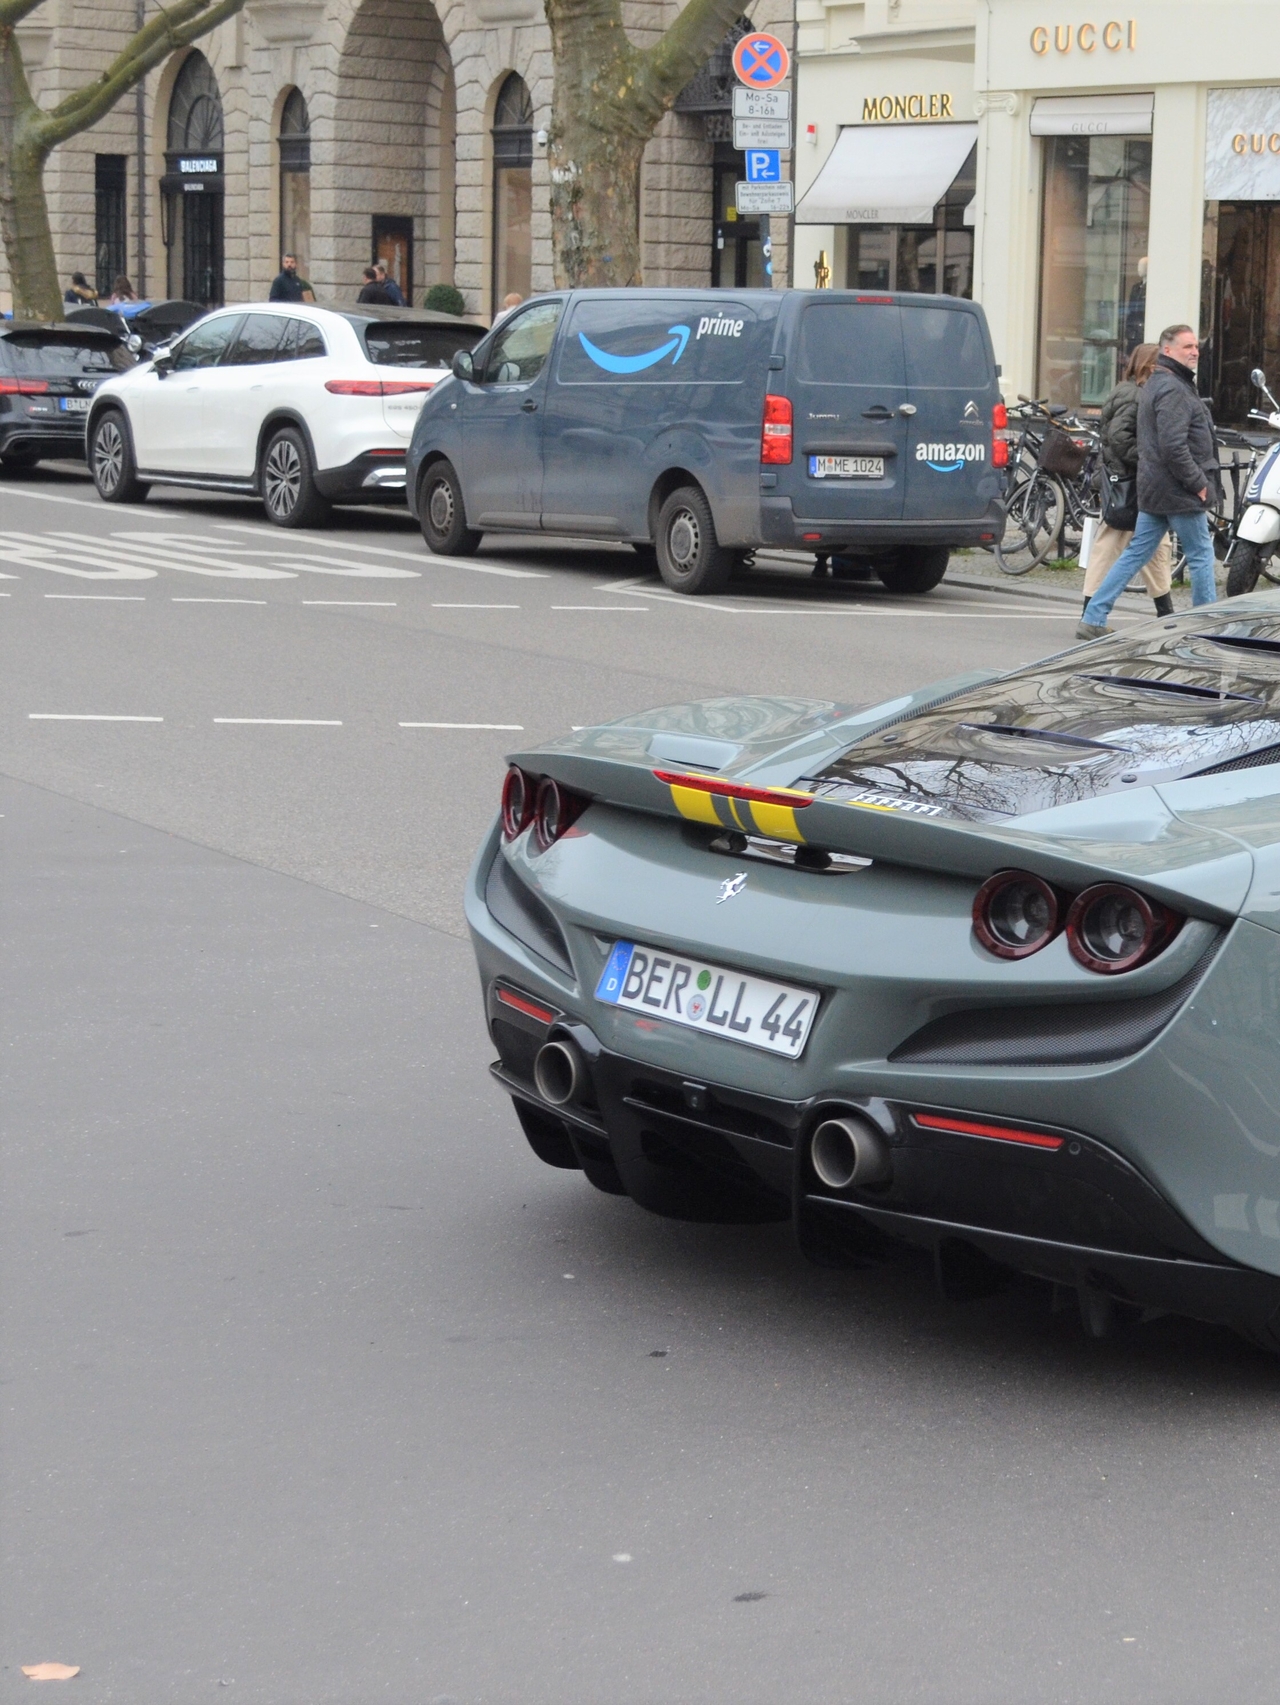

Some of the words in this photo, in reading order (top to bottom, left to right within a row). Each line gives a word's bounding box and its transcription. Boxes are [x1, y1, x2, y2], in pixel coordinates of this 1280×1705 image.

[1030, 19, 1136, 55] GUCCI
[745, 92, 778, 103] Mo-Sa
[862, 93, 953, 121] MONCLER
[748, 105, 775, 115] 8-16h
[1071, 122, 1108, 133] GUCCI
[180, 159, 217, 173] BALENCIAGA
[751, 152, 770, 179] P
[845, 209, 879, 220] MONCLER
[696, 312, 744, 340] prime
[915, 442, 985, 461] amazon
[817, 458, 826, 472] M
[834, 459, 850, 473] ME
[853, 459, 882, 473] 1024
[849, 793, 943, 816] Ferrari
[622, 951, 692, 1014] BER
[706, 974, 752, 1033] LL
[760, 992, 810, 1047] 44
